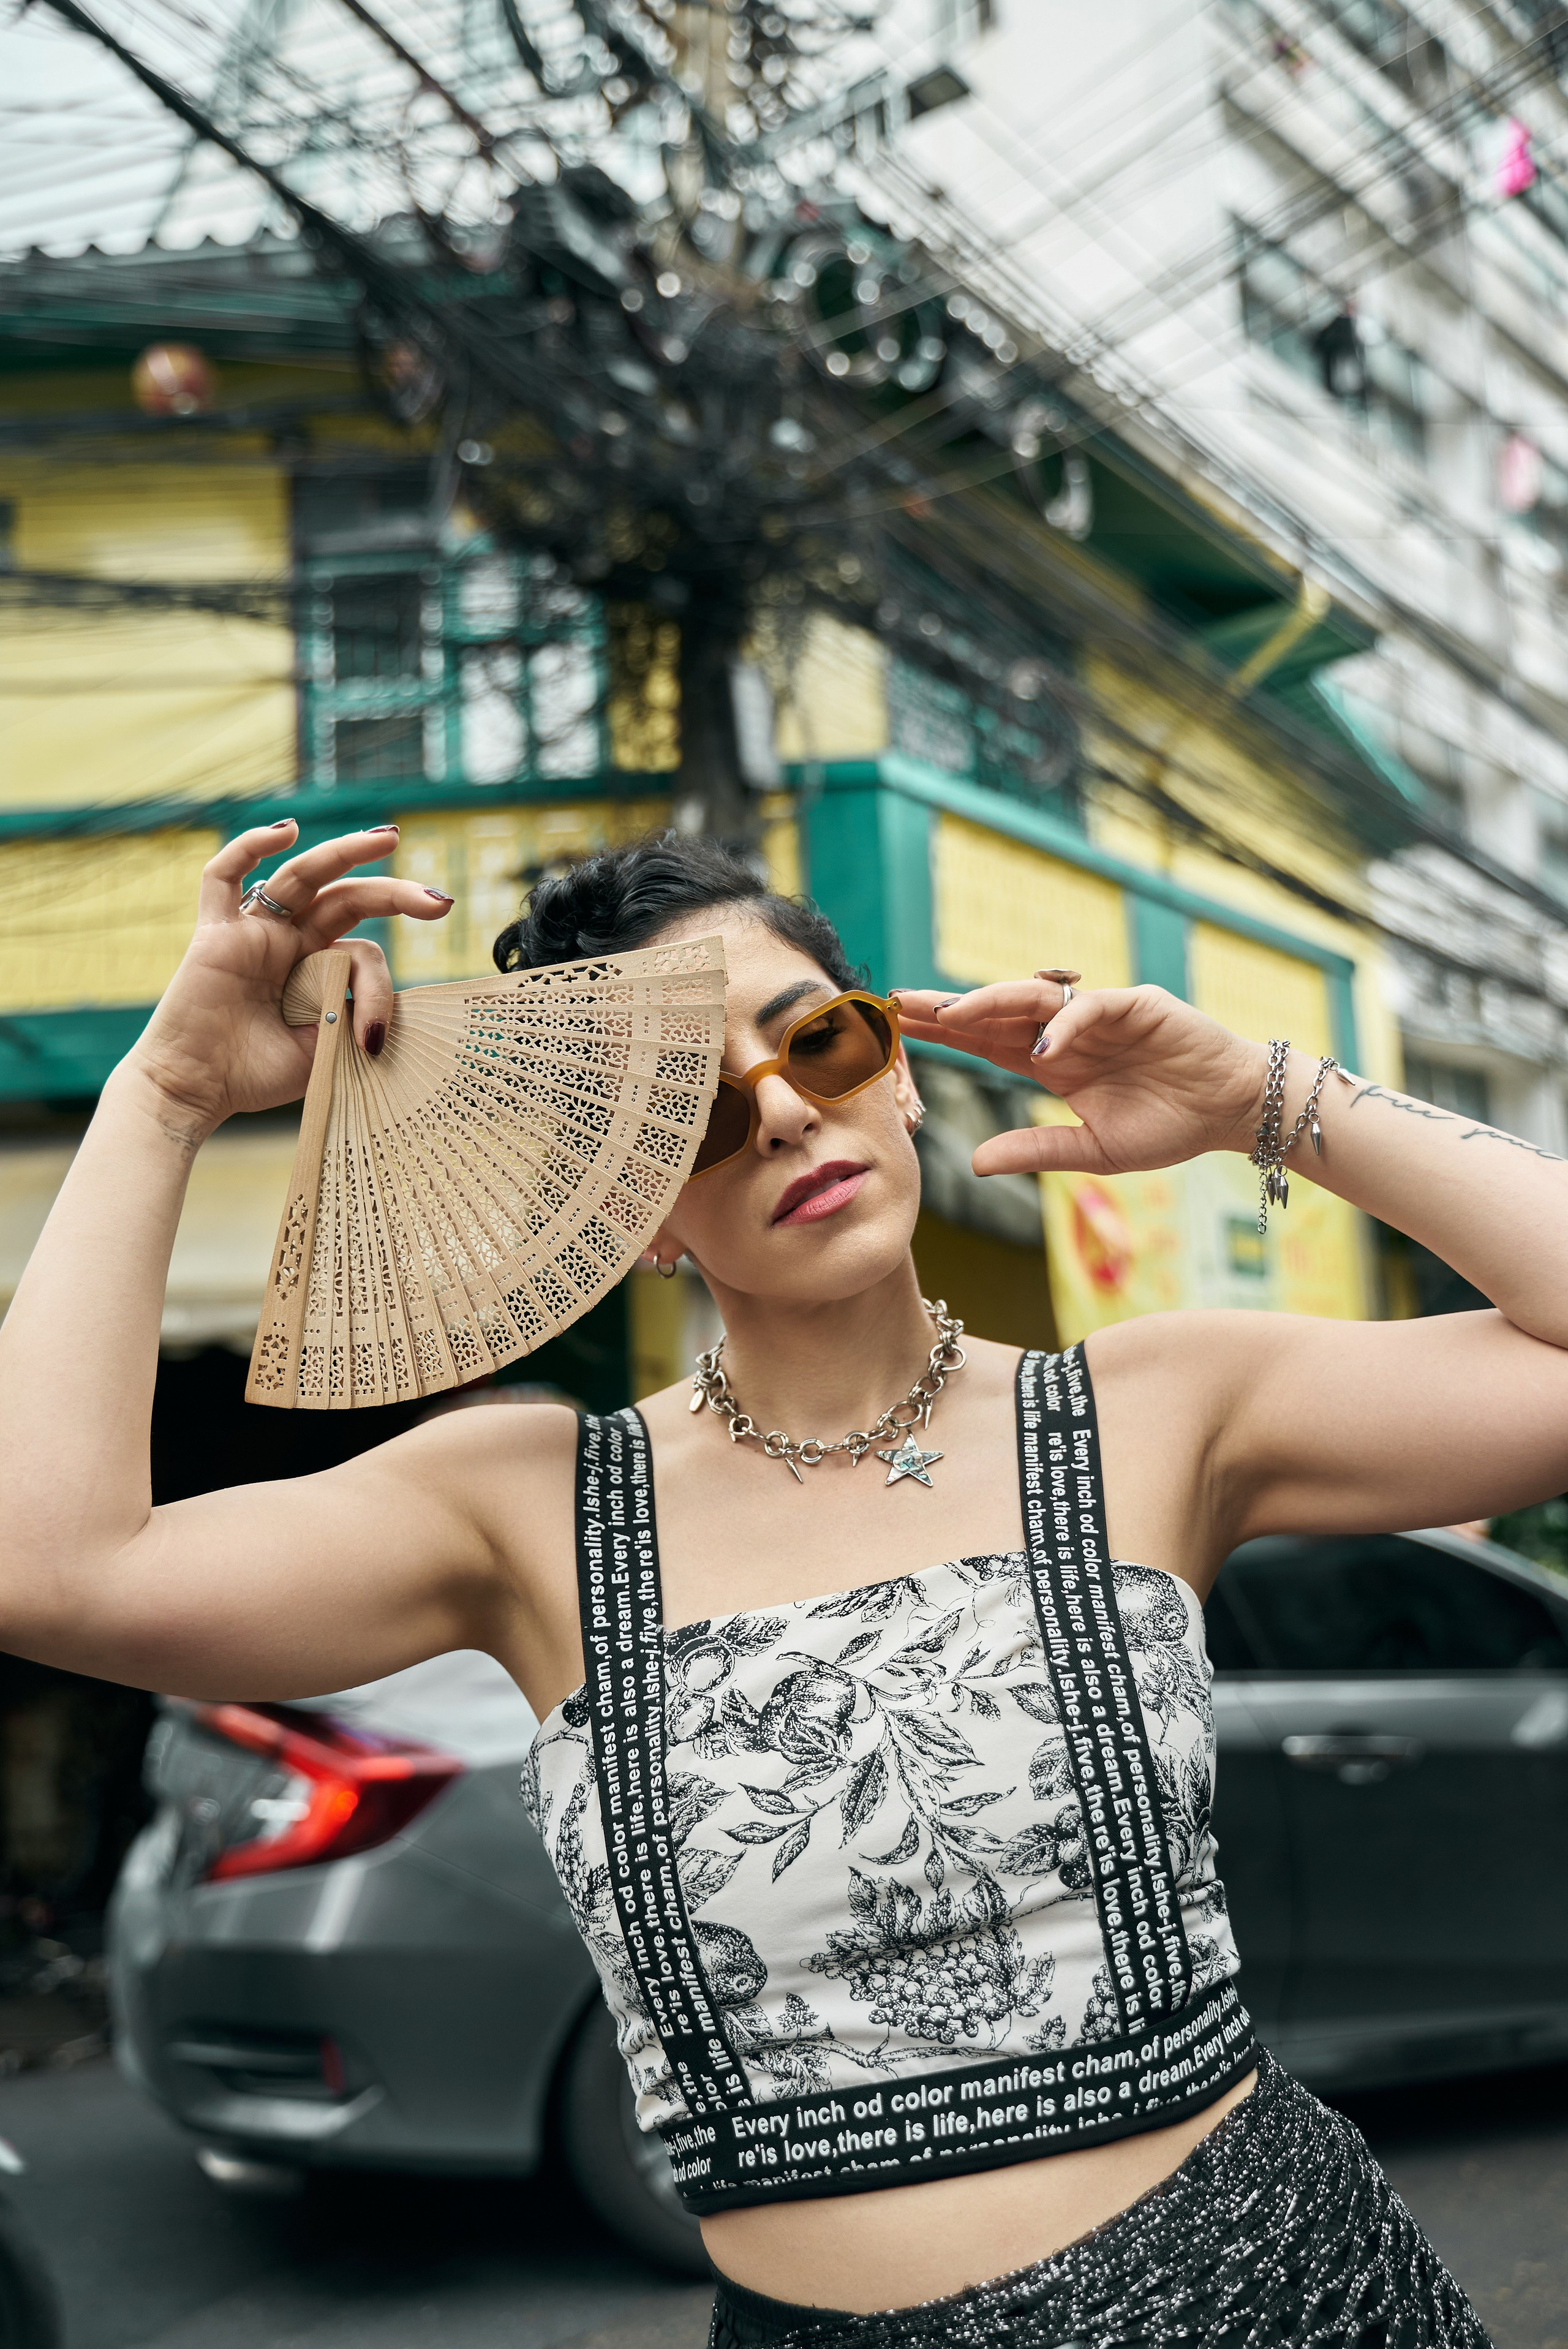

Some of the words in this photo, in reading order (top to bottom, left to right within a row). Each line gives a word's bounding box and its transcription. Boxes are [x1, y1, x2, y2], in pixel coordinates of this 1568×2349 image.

[1022, 1399, 1039, 1408] is
[1044, 1384, 1063, 1412] color
[1023, 1410, 1042, 1429] life
[607, 1426, 623, 1462] color
[629, 1439, 645, 1450] is
[1070, 1429, 1091, 1471] Every
[606, 1464, 623, 1484] od
[1023, 1432, 1044, 1495] manifest
[606, 1490, 625, 1526] inch
[1076, 1476, 1097, 1509] inch
[1079, 1514, 1099, 1534] od
[1057, 1547, 1075, 1560] is
[1082, 1538, 1102, 1580] color
[1088, 1584, 1121, 1659] manifest
[1075, 1637, 1093, 1653] is
[621, 1657, 634, 1669] a
[1080, 1659, 1102, 1699] also
[620, 1675, 637, 1717] also
[1091, 1705, 1106, 1717] a
[622, 1724, 638, 1743] is
[600, 1722, 623, 1815] manifest
[612, 1822, 631, 1878] color
[635, 1842, 649, 1862] is
[618, 1885, 636, 1914] od
[1127, 1866, 1148, 1916] inch
[627, 1920, 651, 1970] inch
[1136, 1921, 1156, 1950] od
[671, 1937, 716, 2032] manifest
[1142, 1955, 1163, 2008] color
[643, 1977, 674, 2038] Every
[1125, 1991, 1142, 2015] is
[708, 2038, 733, 2070] life
[725, 2073, 744, 2094] is
[731, 2113, 790, 2138] Every
[796, 2100, 845, 2128] inch
[853, 2092, 883, 2119] od
[891, 2084, 953, 2113] color
[960, 2061, 1065, 2100] manifest
[687, 2156, 711, 2179] color
[905, 2119, 925, 2142] is
[1036, 2095, 1055, 2117] is
[1063, 2086, 1111, 2111] also
[1118, 2081, 1131, 2098] a
